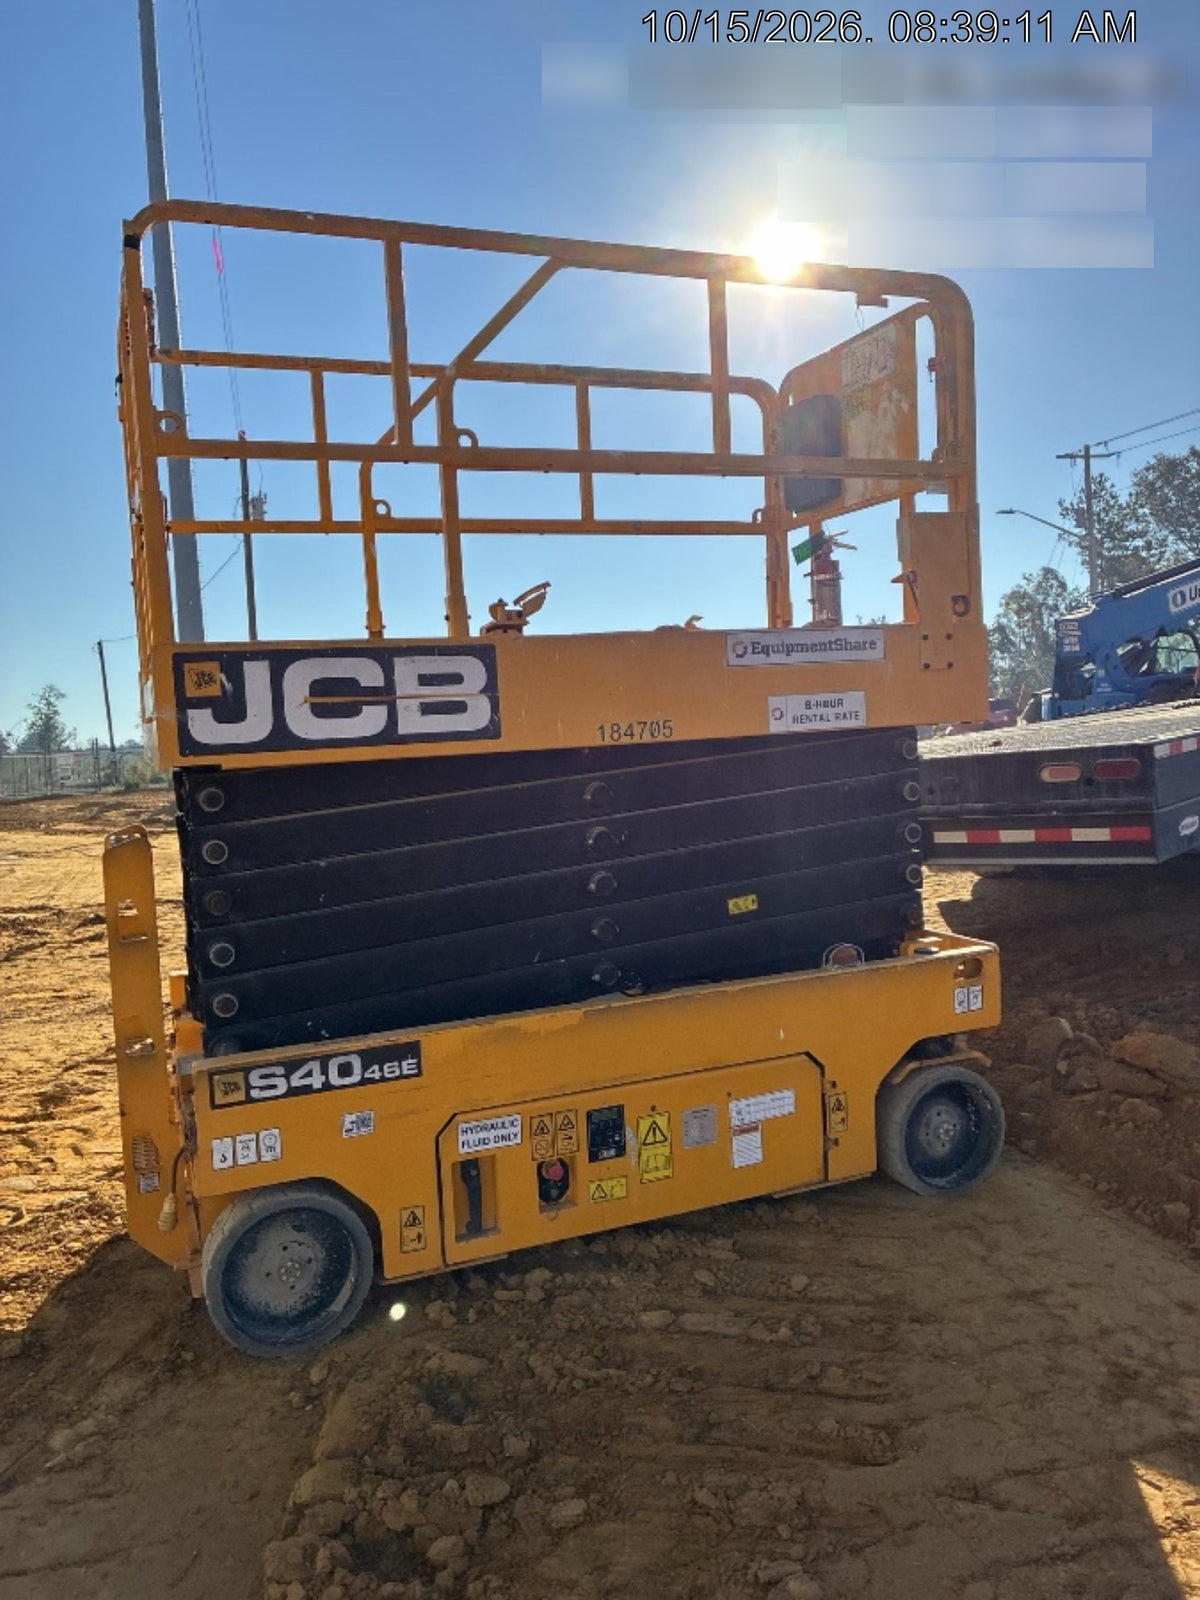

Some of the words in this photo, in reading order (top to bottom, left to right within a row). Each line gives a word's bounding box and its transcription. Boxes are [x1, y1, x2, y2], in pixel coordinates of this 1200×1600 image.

[750, 638, 878, 657] EquipmentShare
[187, 656, 491, 744] JCB
[805, 698, 844, 710] 8-HOUR
[792, 714, 831, 725] RENTAL
[835, 711, 861, 722] RATE
[597, 719, 673, 742] 184705
[461, 1118, 519, 1136] HYDRAULIC
[461, 1137, 491, 1149] FLUID
[494, 1131, 519, 1144] ONLY
